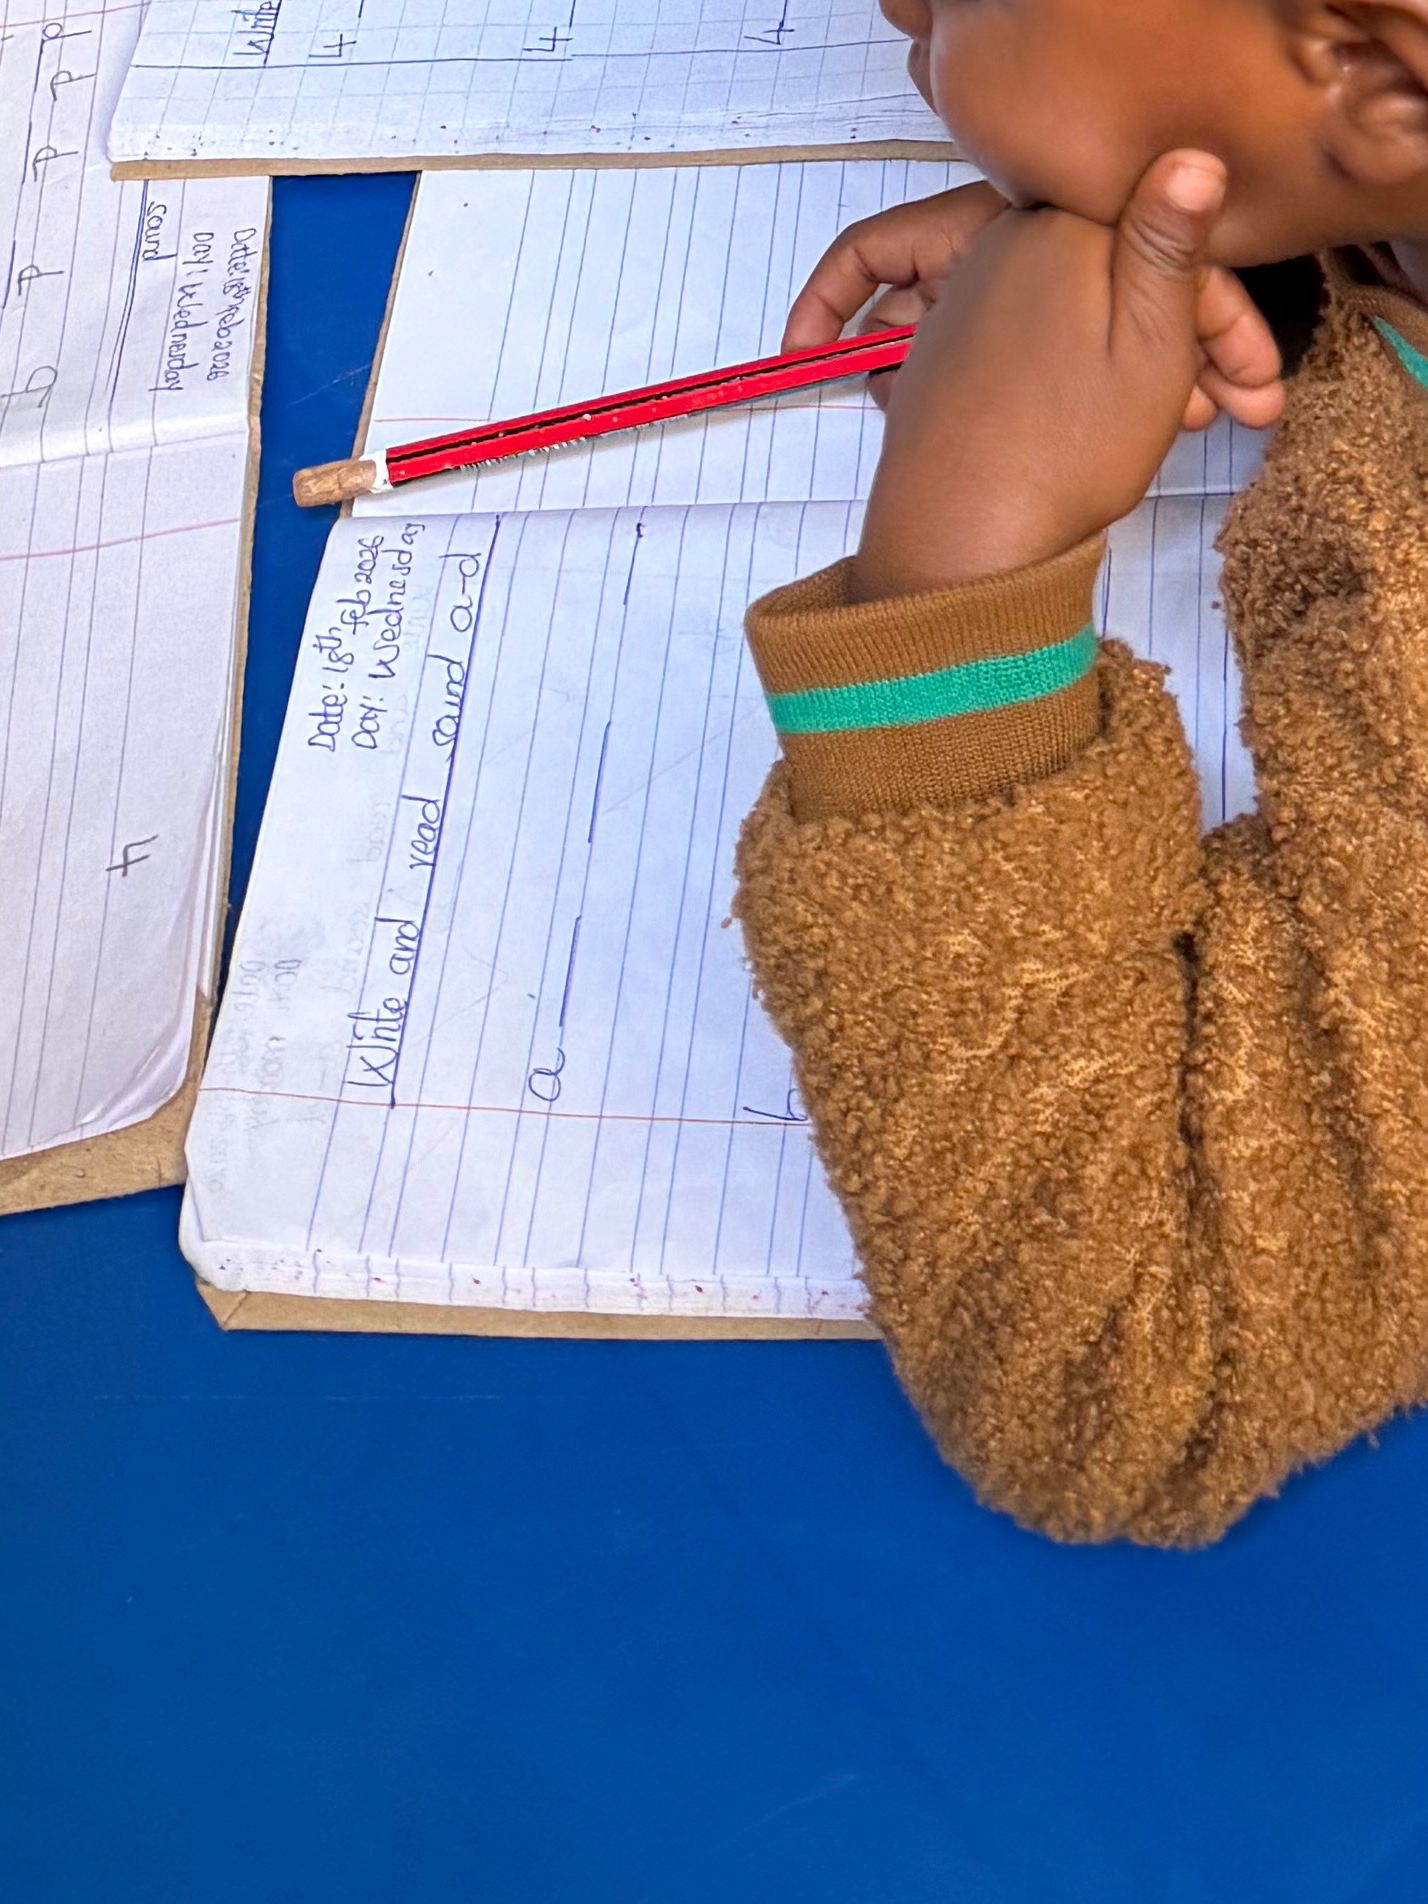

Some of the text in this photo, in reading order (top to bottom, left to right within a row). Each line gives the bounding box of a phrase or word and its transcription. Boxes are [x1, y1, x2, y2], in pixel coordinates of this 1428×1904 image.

[143, 201, 177, 261] sound
[349, 530, 385, 586] 2026
[345, 552, 479, 1085] Write and read sound a-d
